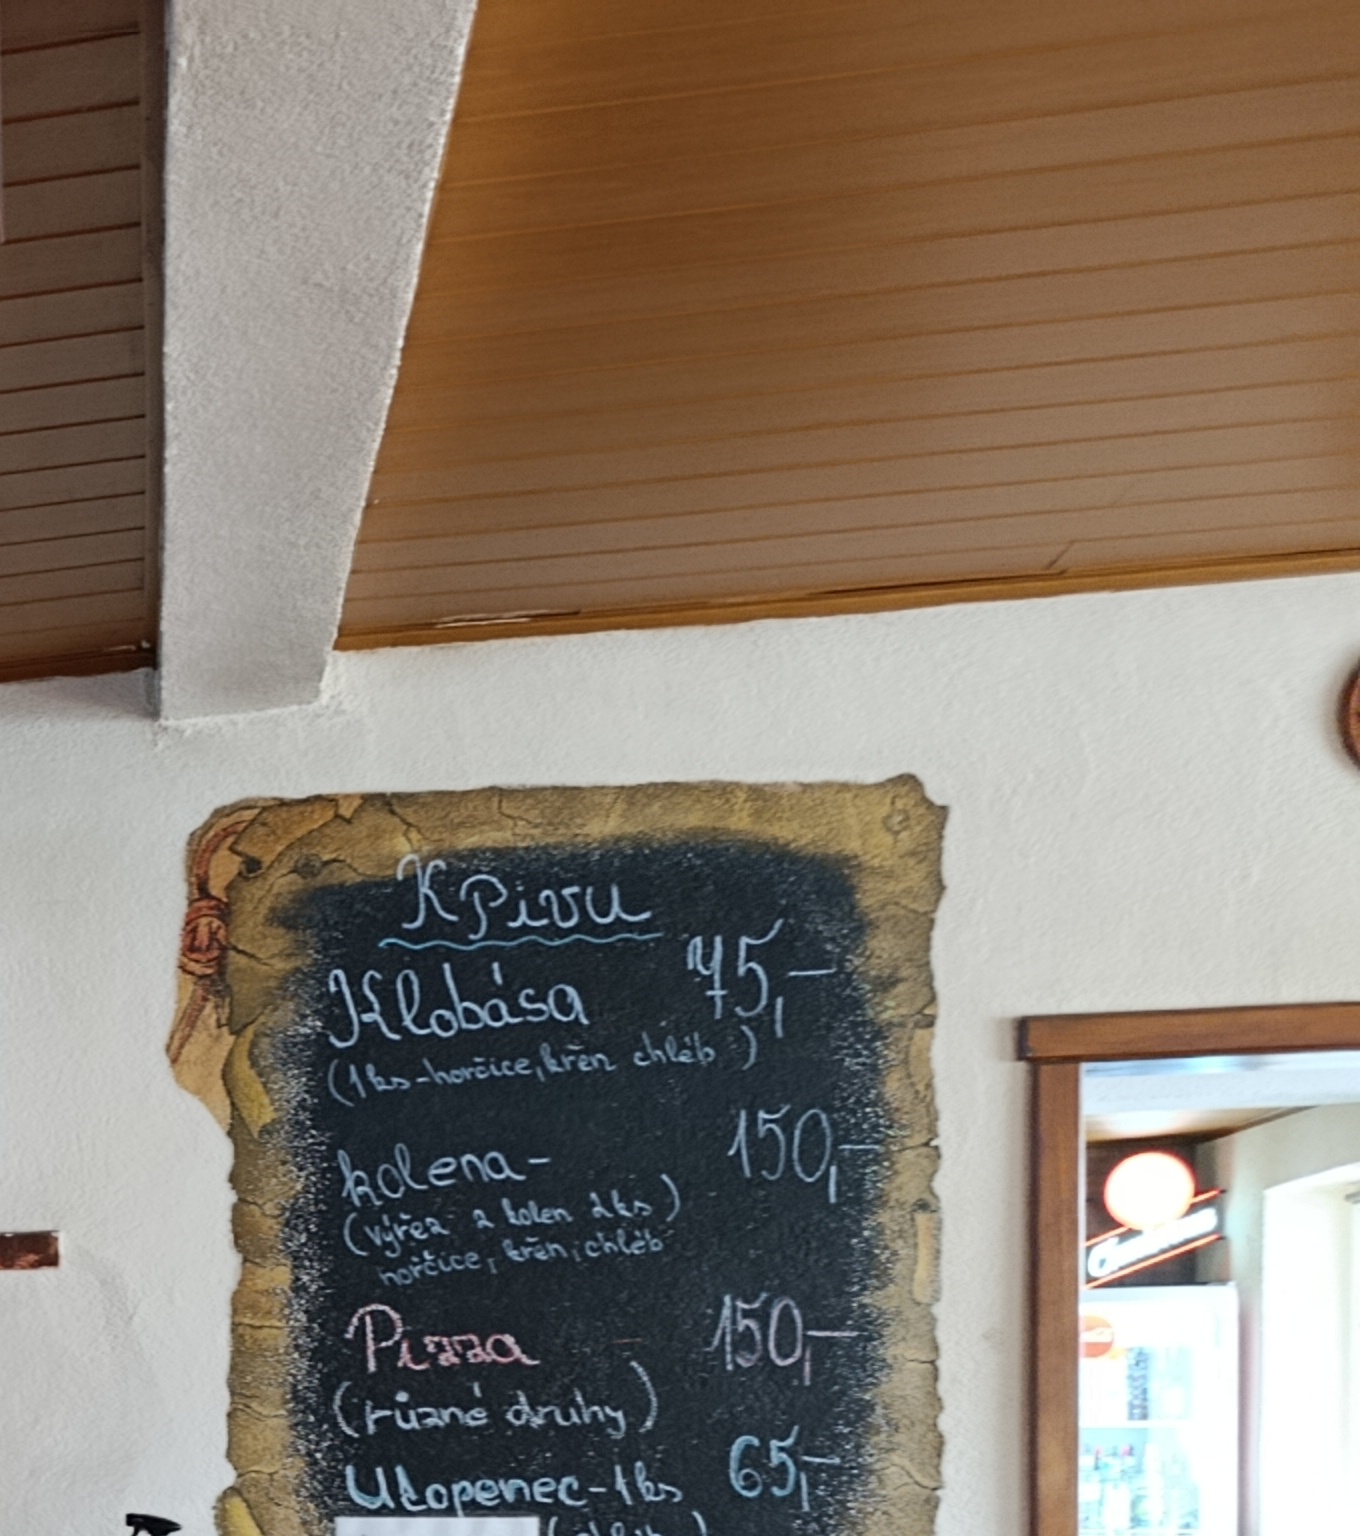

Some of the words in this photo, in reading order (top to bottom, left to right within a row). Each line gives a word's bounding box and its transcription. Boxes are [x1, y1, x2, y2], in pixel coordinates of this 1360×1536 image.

[396, 853, 459, 929] K
[328, 961, 590, 1048] Klobása
[501, 1196, 574, 1226] kolen
[343, 1302, 542, 1374] Pizza
